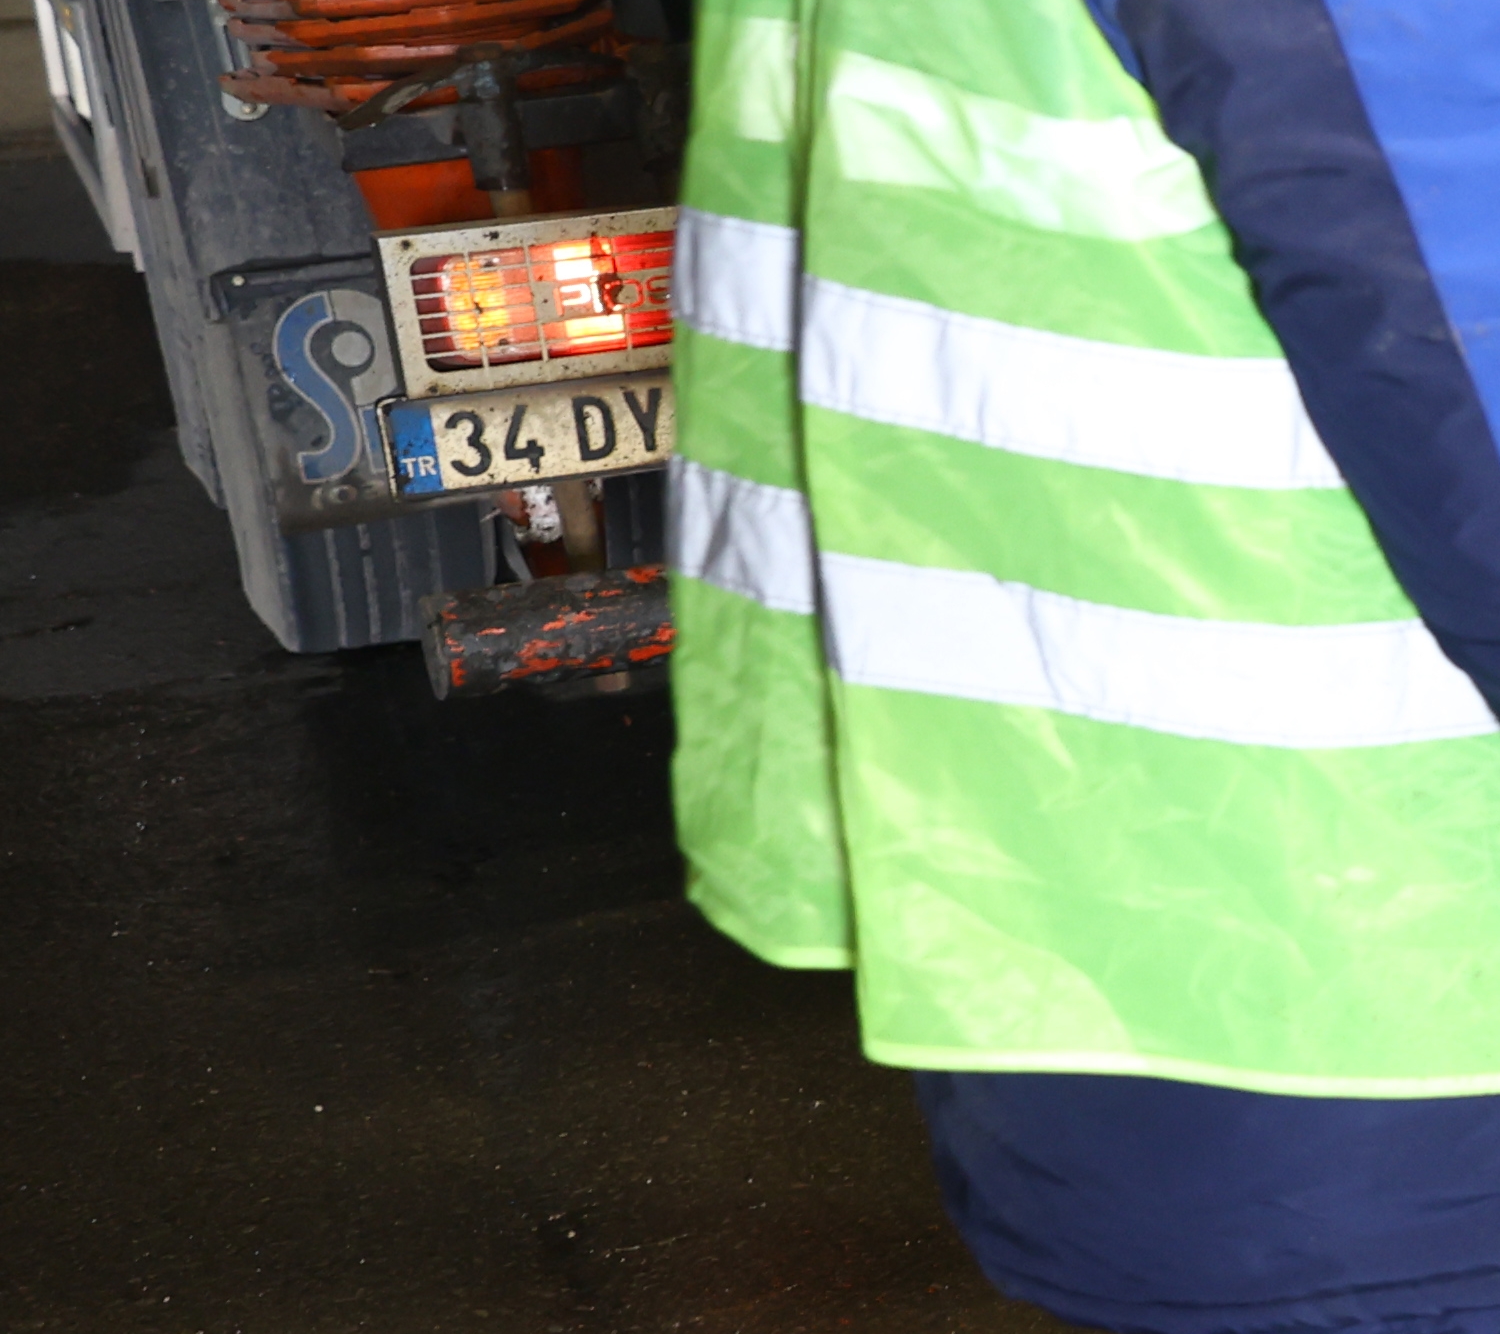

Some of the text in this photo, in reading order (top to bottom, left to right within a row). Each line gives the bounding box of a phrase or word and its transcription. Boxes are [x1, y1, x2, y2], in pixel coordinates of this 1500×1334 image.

[444, 386, 663, 476] 34 DY
[401, 455, 437, 479] TR
